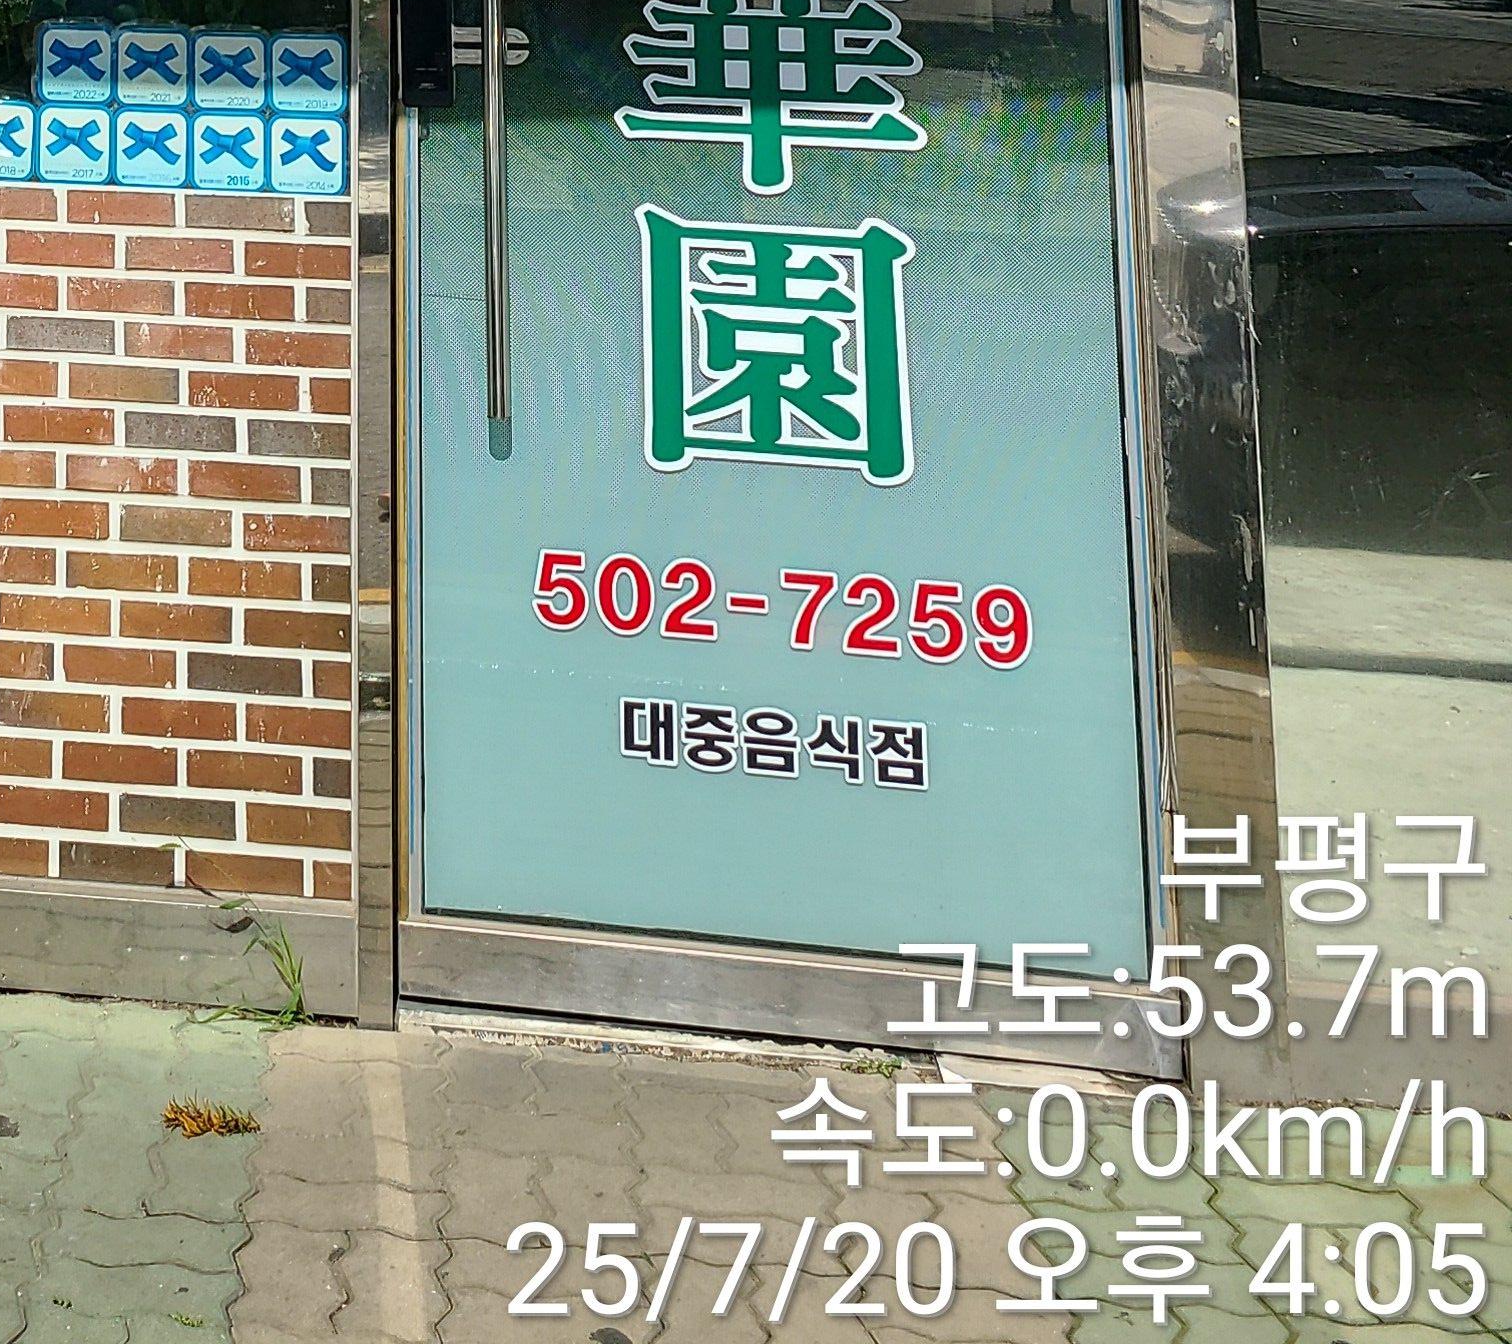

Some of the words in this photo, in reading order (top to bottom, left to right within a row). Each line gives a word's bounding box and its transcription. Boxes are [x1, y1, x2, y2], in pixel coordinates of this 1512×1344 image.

[73, 89, 96, 99] 2022
[72, 169, 94, 178] 2017
[537, 552, 1029, 664] 502-7259
[622, 700, 926, 788] 대중음식점
